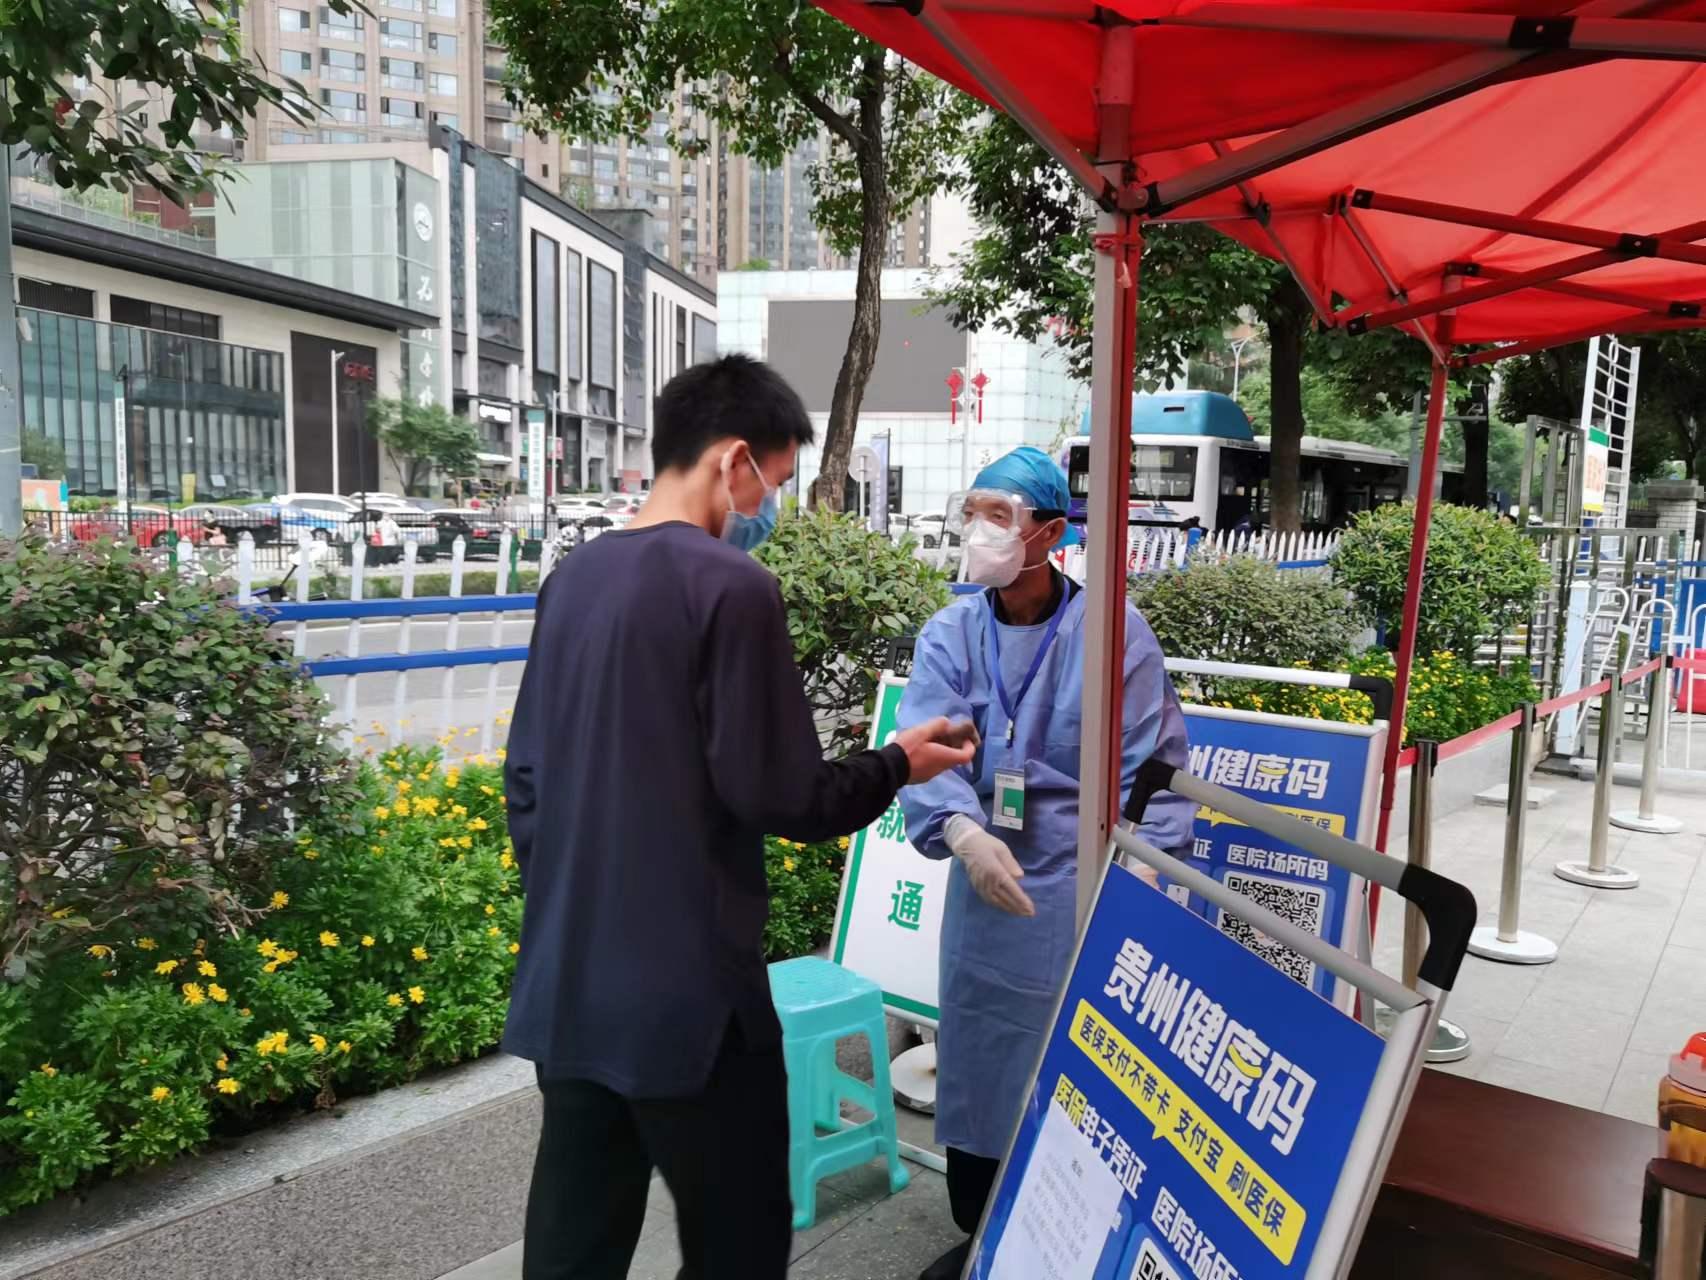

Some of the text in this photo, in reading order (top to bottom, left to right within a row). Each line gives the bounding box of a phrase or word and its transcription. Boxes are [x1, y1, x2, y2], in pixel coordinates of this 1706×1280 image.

[1192, 838, 1213, 861] 证
[1225, 842, 1330, 881] 医院场所码
[887, 879, 925, 931] 通
[1103, 937, 1317, 1156] 贵州健康码
[1053, 1072, 1149, 1200] 医保电子凭证
[1079, 1013, 1287, 1238] 医保支付不带卡 支付宝 刷医保
[1151, 1185, 1244, 1280] 医院场所
